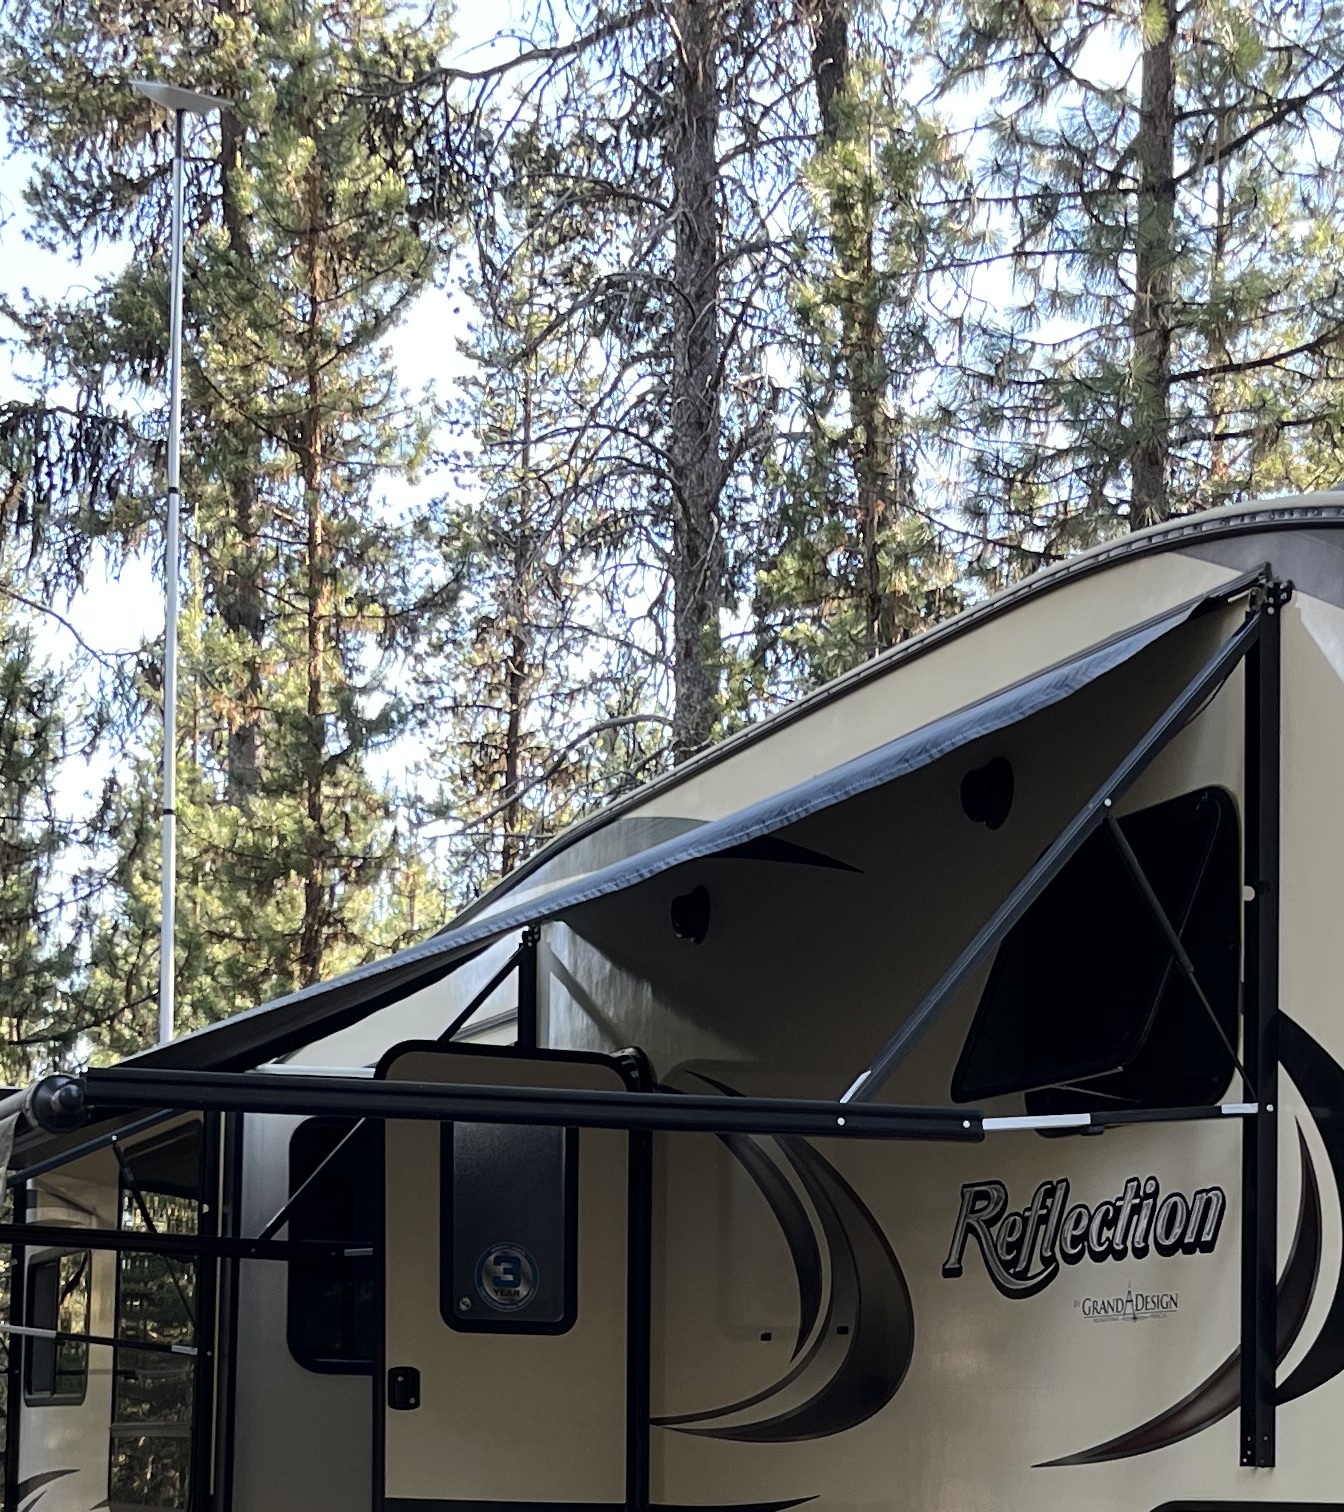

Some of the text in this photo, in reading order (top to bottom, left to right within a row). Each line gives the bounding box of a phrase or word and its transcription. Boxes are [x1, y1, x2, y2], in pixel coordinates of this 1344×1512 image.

[942, 1175, 1226, 1300] Reflection
[492, 1255, 522, 1289] 3
[492, 1288, 521, 1298] YEAR
[1082, 1297, 1125, 1316] GRAND
[1135, 1292, 1179, 1312] DESIGN
